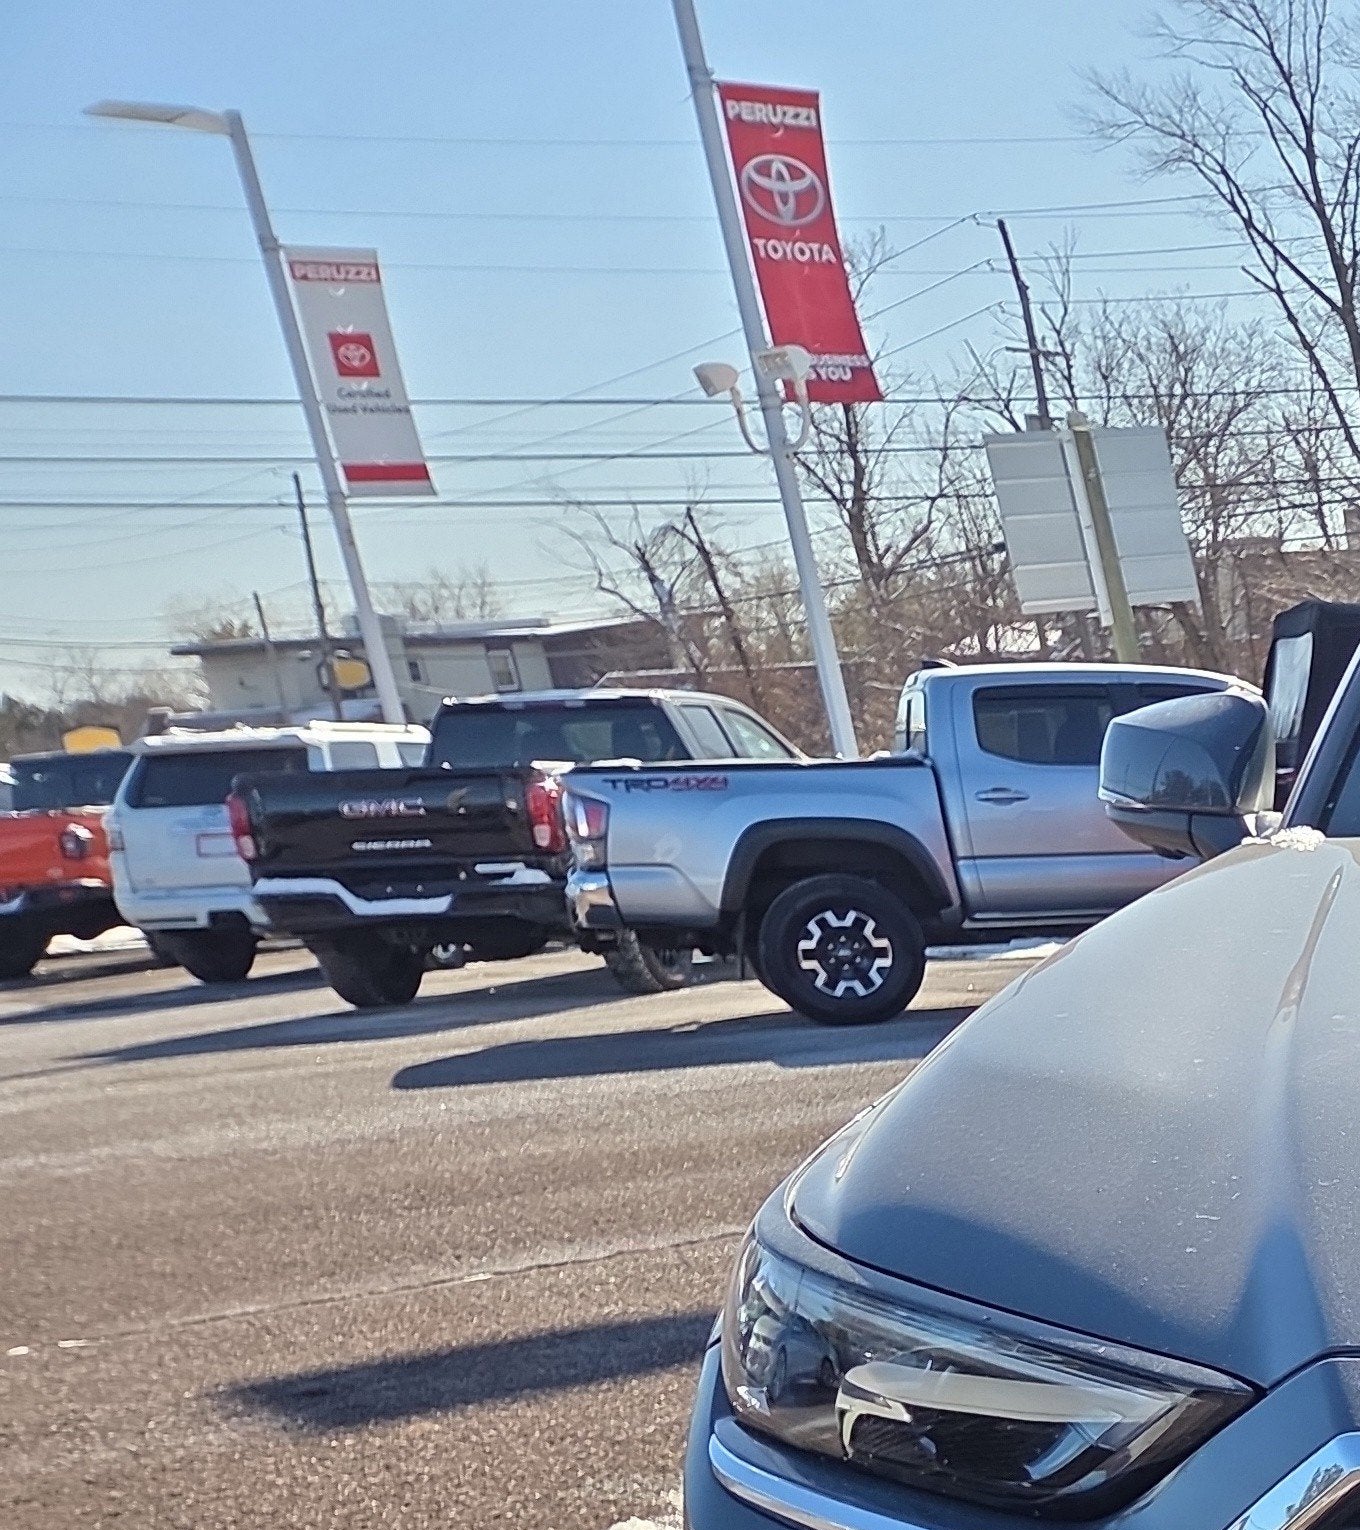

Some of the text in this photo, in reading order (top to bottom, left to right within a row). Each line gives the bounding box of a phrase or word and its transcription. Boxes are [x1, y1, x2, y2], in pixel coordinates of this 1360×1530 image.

[726, 99, 818, 128] PERUZZI
[753, 237, 837, 264] TOYOTA
[816, 366, 853, 382] YOU
[338, 798, 426, 819] GMC
[351, 838, 433, 851] SIERRA
